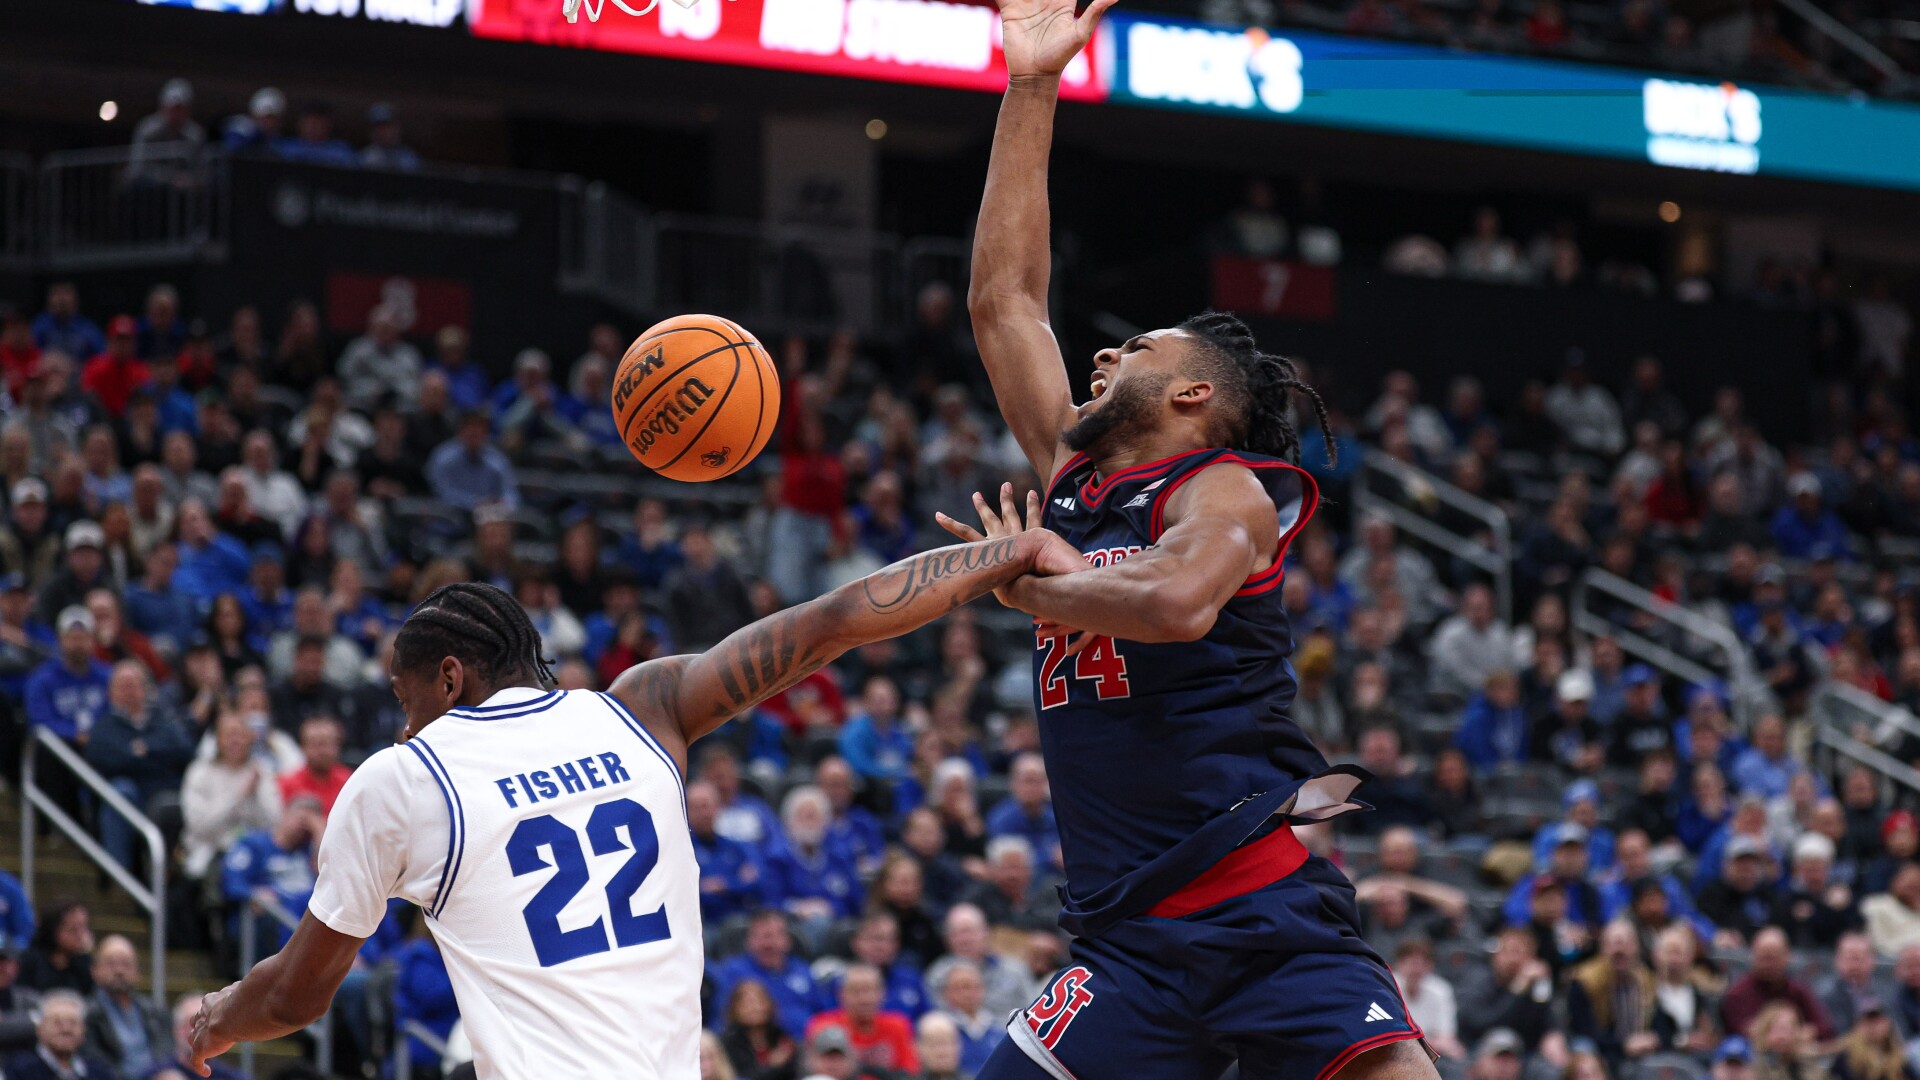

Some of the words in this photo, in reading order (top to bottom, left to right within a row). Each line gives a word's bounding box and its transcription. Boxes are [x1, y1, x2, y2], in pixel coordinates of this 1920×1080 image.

[614, 345, 665, 413] NCAA
[632, 376, 716, 456] Wilson
[1037, 624, 1130, 710] 24
[494, 751, 631, 809] FISHER
[505, 797, 672, 968] 22
